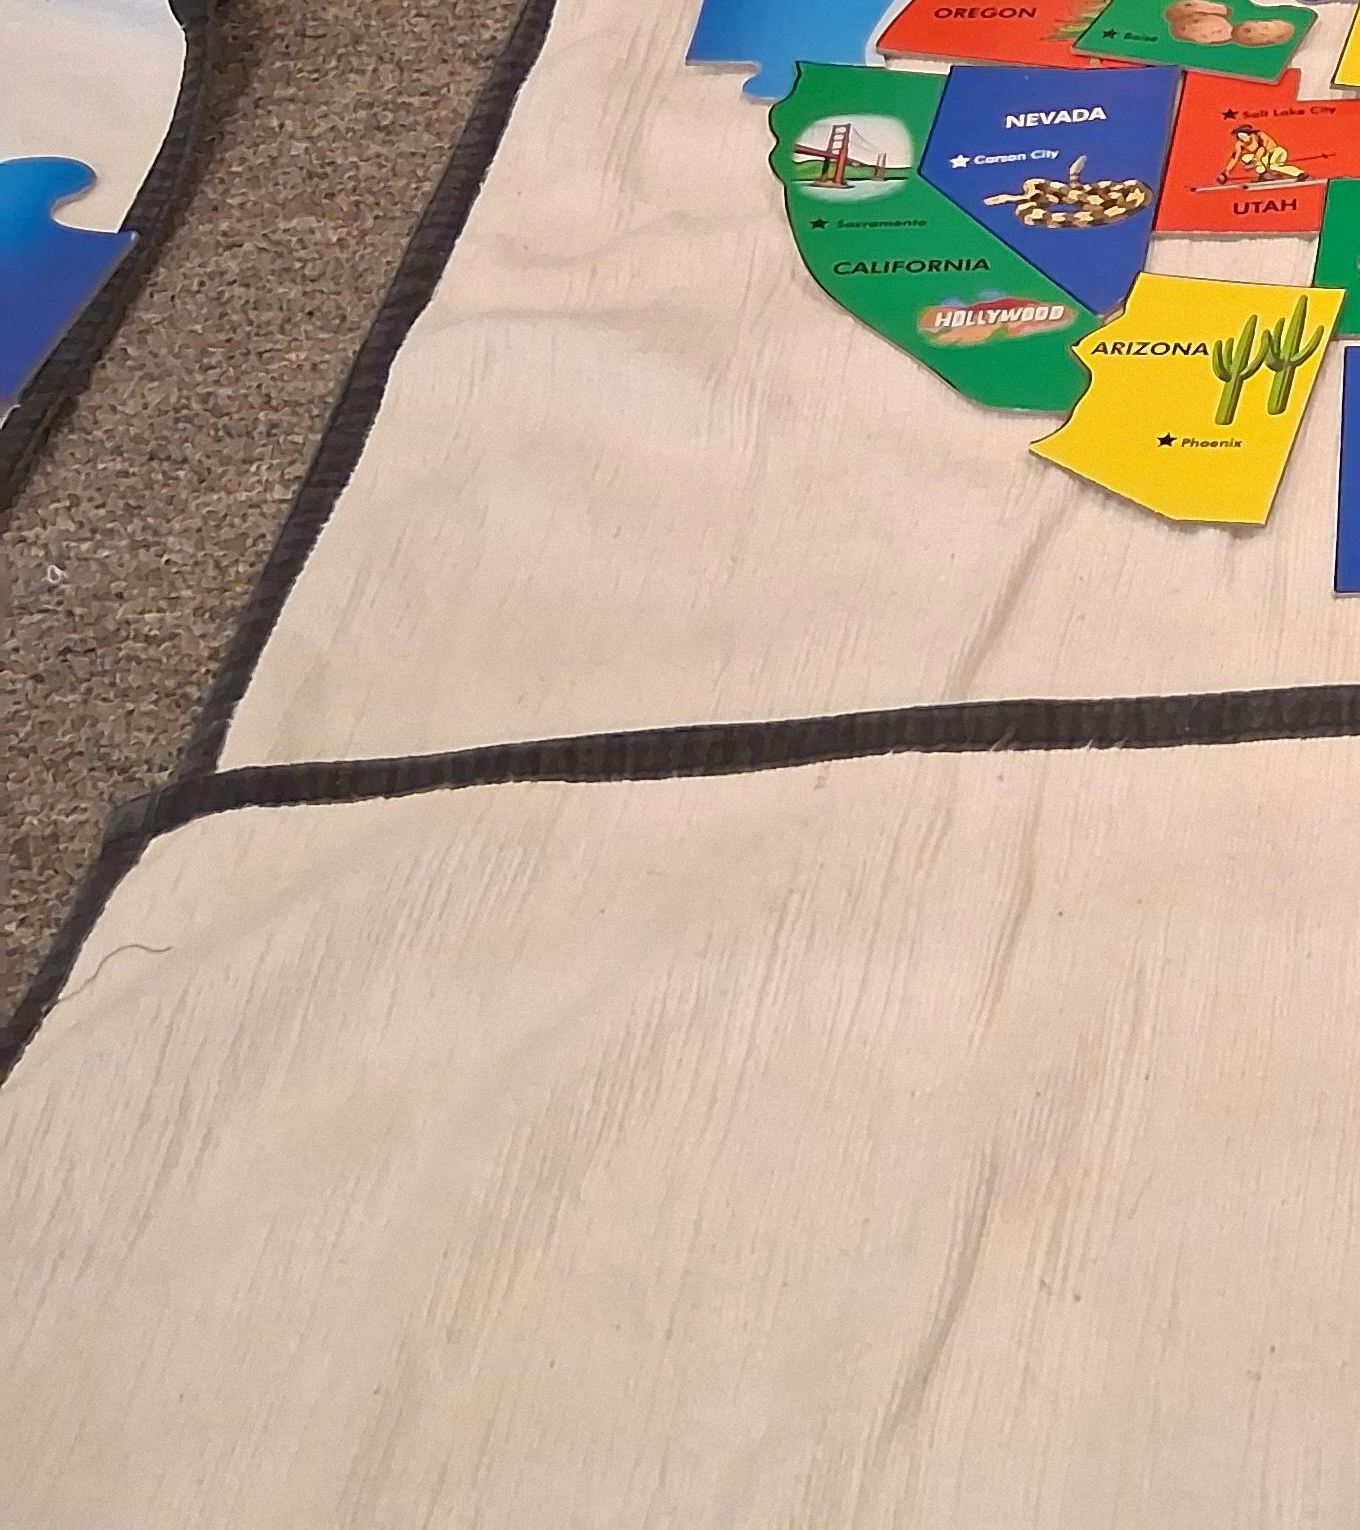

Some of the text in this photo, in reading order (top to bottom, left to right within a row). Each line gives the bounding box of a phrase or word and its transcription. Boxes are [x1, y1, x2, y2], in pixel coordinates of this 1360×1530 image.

[934, 6, 1037, 20] OREGON
[1005, 107, 1107, 129] NEVADA
[1243, 105, 1336, 119] Salt Lake City
[973, 149, 1059, 165] Carson City
[1232, 198, 1297, 215] UTAH
[837, 218, 928, 228] Sacramento
[833, 258, 990, 276] CALIFORNIA
[933, 305, 1065, 328] HOLLYWOOD
[1091, 341, 1209, 356] ARIZONA
[1181, 436, 1242, 449] Phoenix
